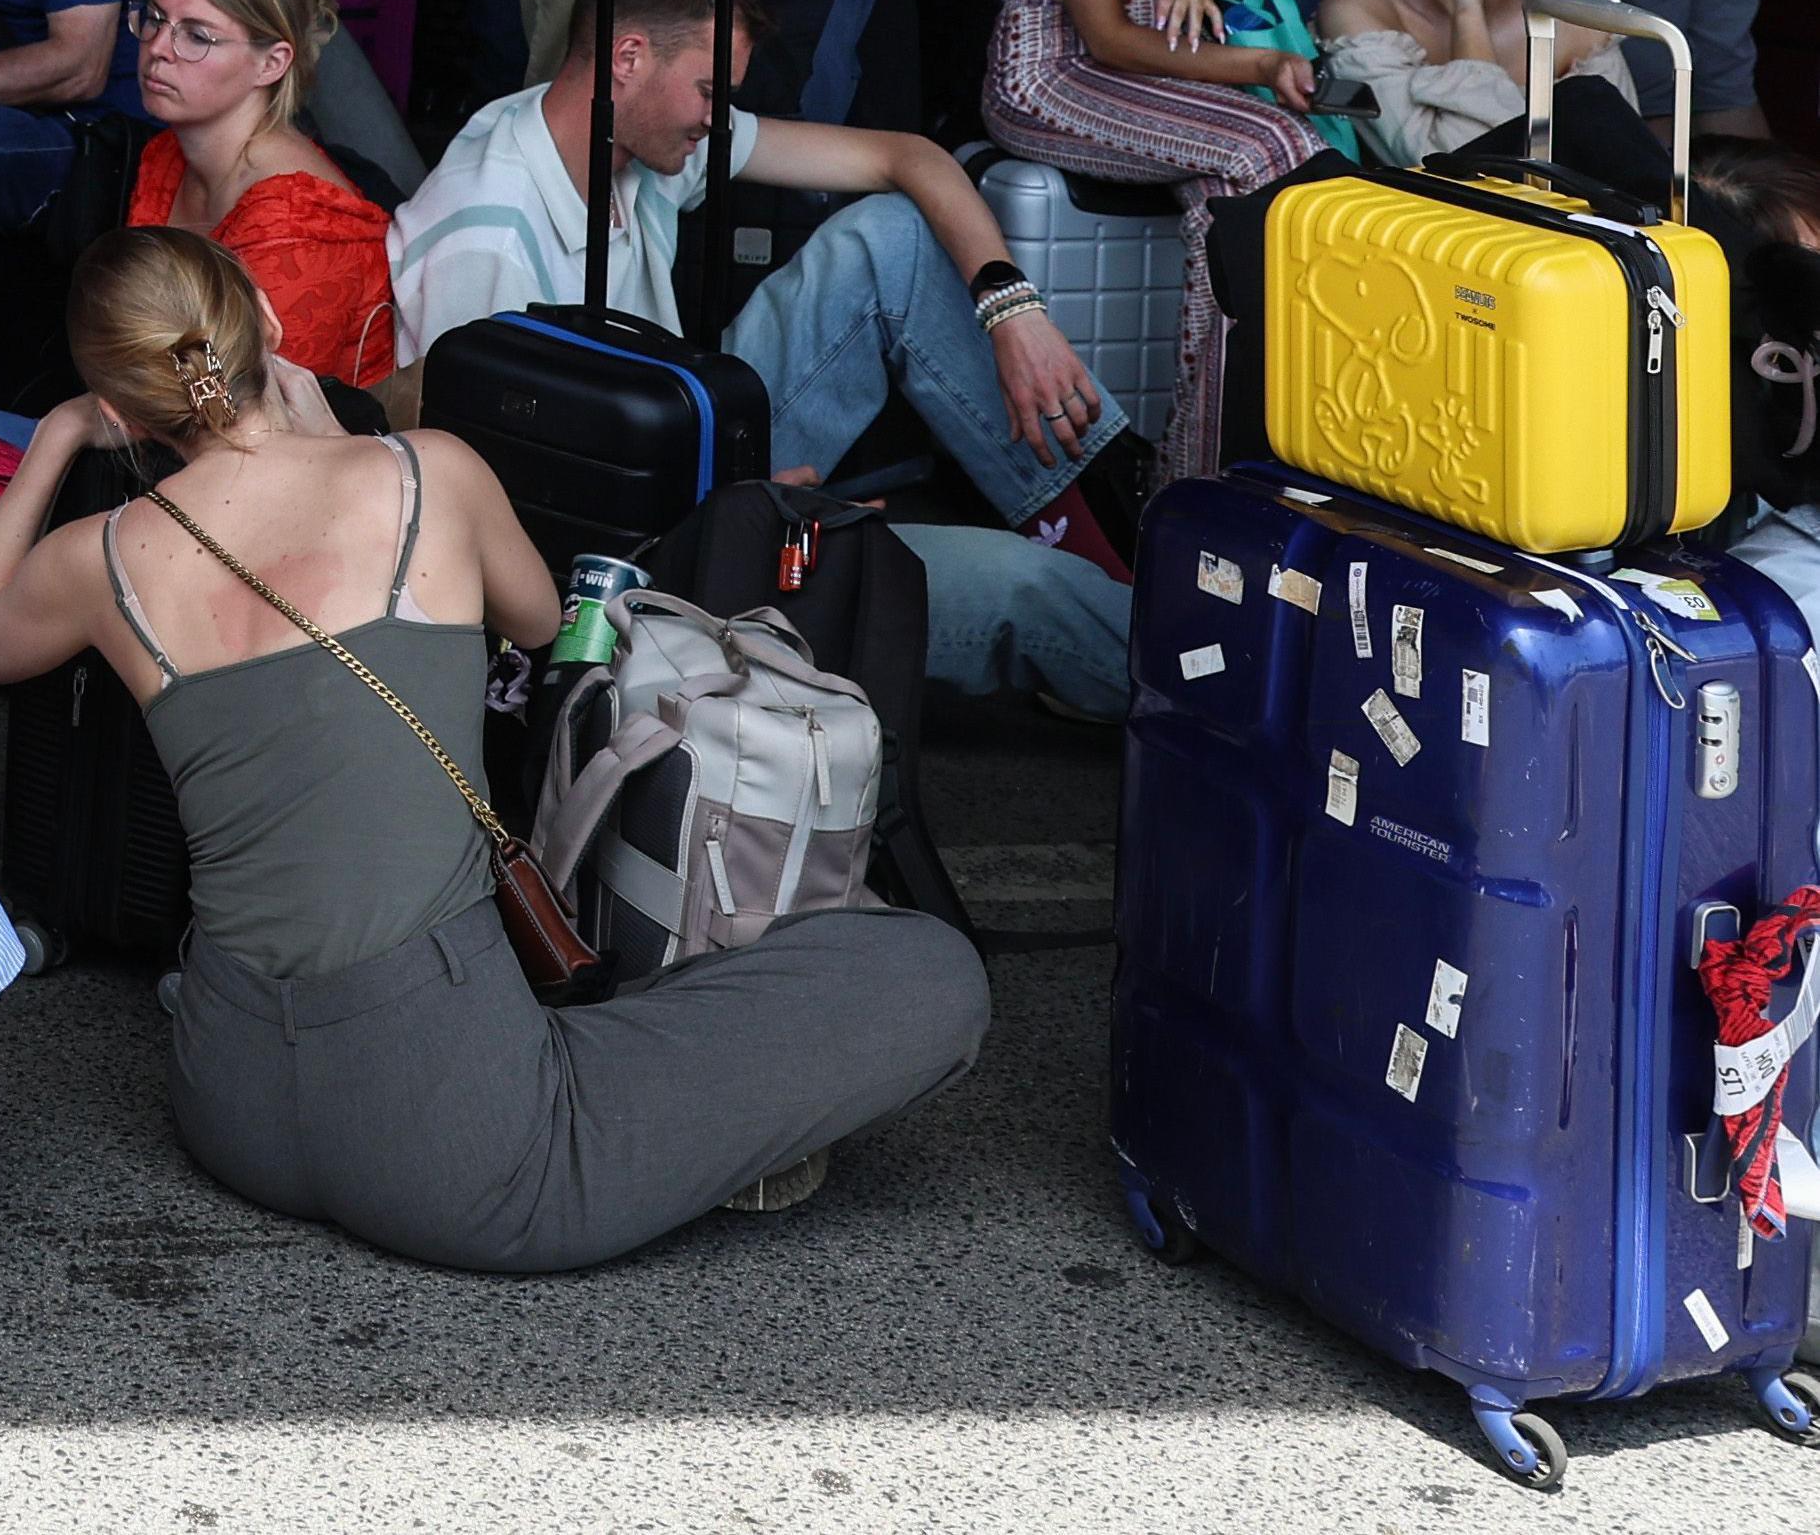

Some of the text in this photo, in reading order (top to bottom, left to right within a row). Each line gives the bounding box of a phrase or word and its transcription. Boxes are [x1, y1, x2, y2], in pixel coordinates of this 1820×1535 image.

[1454, 311, 1496, 332] TWOSOME
[1369, 823, 1451, 864] TOURISTER
[1370, 814, 1451, 854] AMERICAN
[1754, 1048, 1777, 1081] DOH
[1718, 1066, 1747, 1097] LIS
